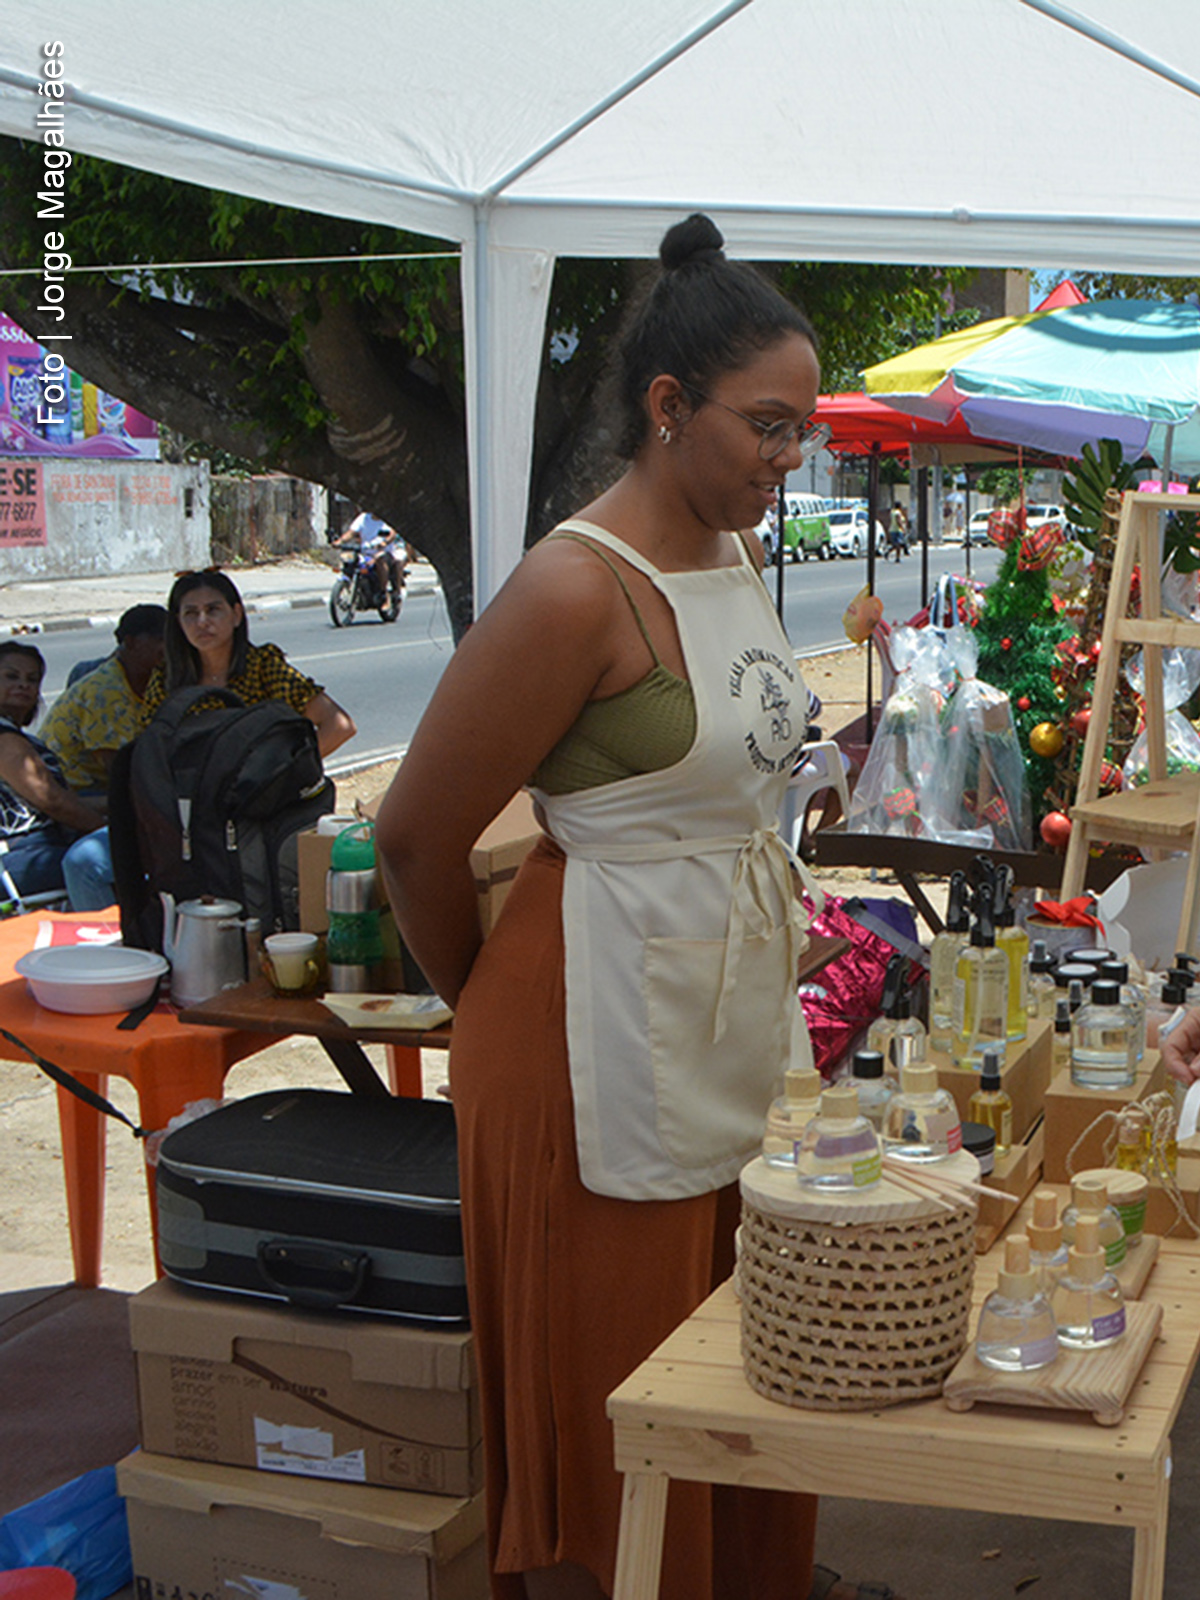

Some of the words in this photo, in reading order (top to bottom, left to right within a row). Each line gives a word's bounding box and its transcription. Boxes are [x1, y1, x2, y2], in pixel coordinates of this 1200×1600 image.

[171, 1365, 213, 1382] prazer
[269, 1380, 328, 1398] natura
[171, 1380, 215, 1397] amor
